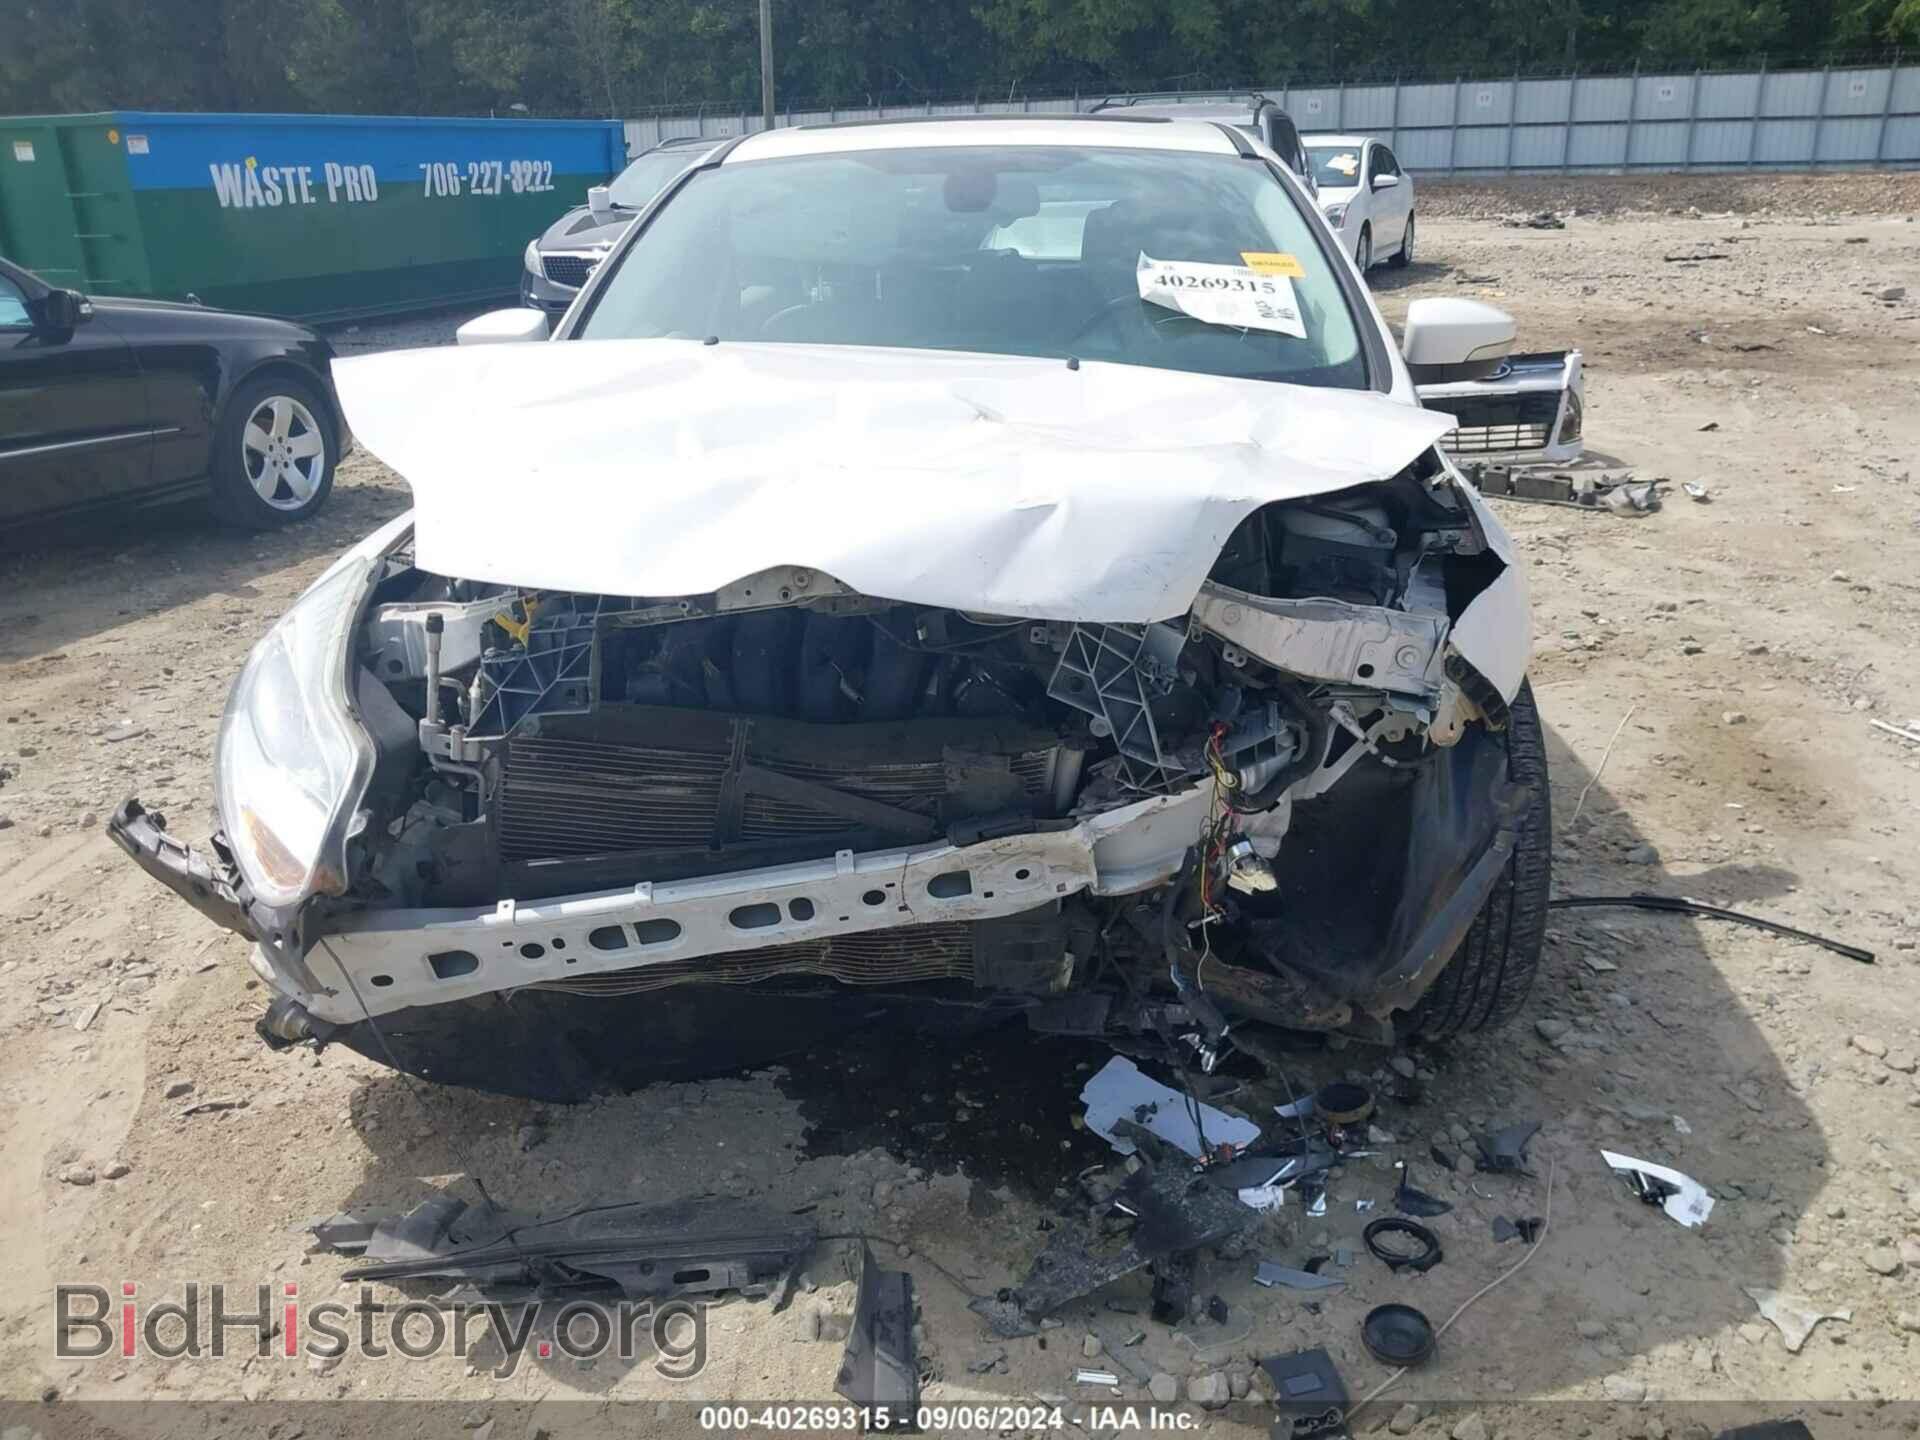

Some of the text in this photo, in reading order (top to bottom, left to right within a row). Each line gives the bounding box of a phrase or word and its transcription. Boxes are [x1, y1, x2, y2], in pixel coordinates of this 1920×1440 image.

[209, 162, 378, 208] WASTE PRO
[1154, 274, 1276, 295] 40269315
